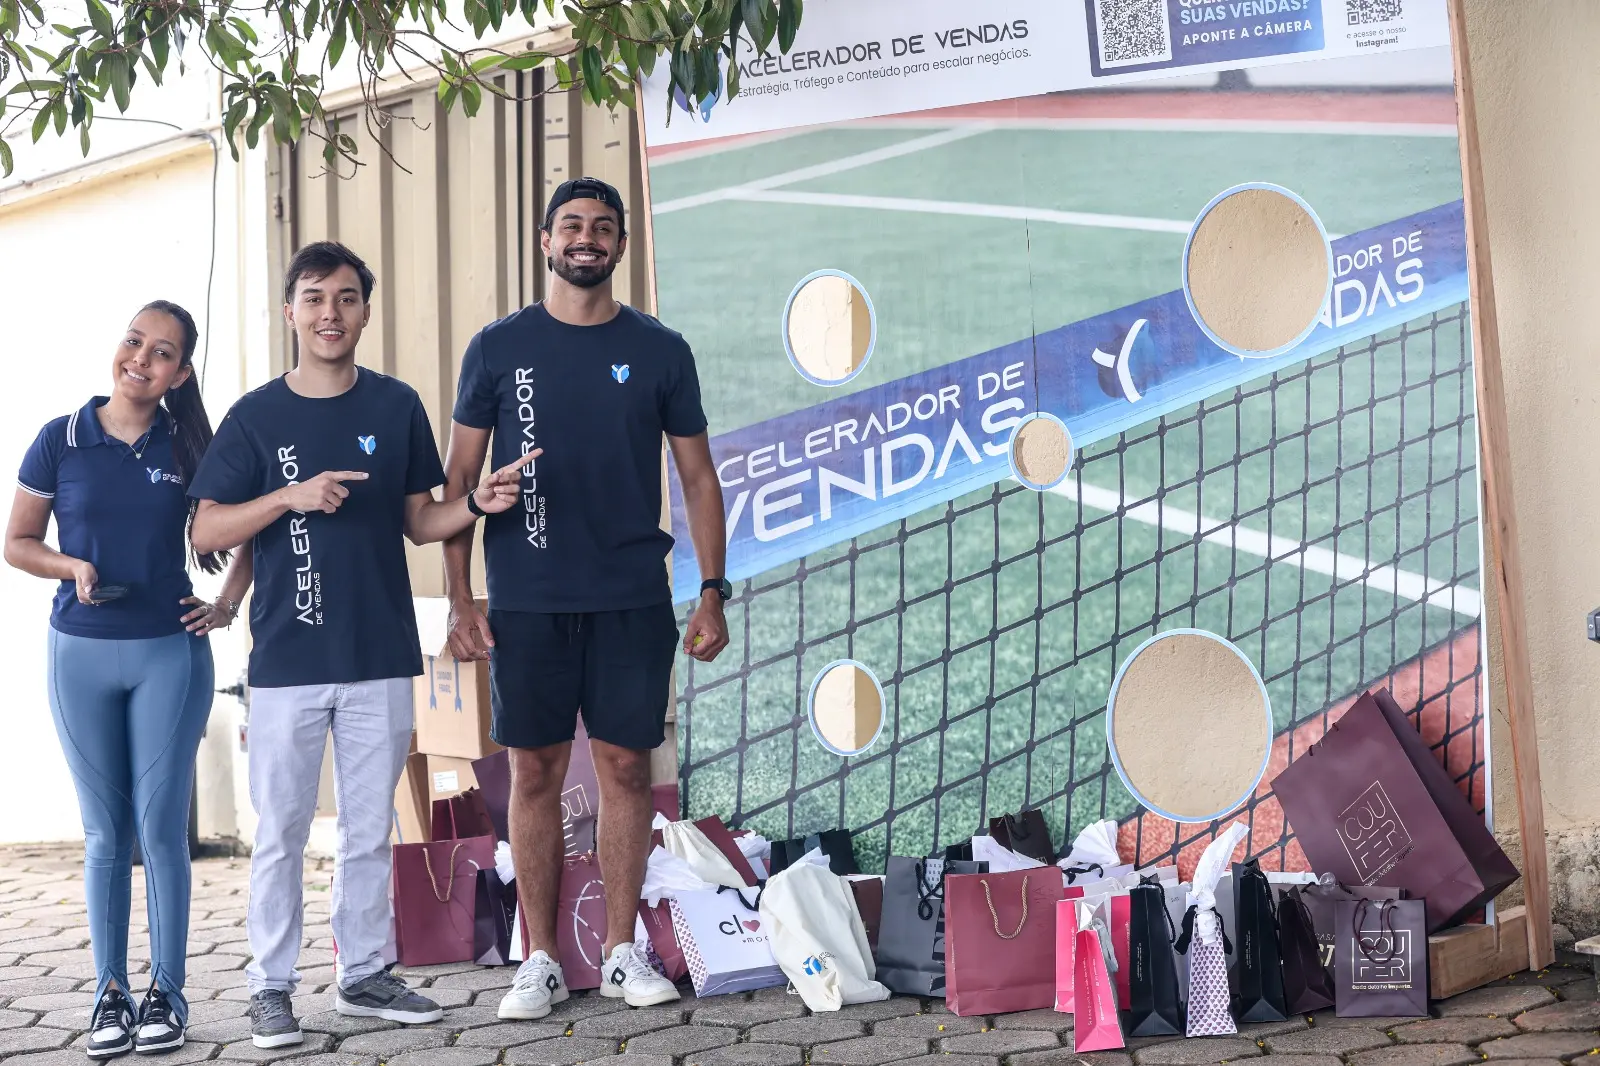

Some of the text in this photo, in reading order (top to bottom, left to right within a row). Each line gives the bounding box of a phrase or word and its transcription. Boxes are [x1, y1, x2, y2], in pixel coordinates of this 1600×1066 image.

[1180, 5, 1226, 25] SUAS
[1182, 19, 1313, 46] APONTE A CÂMERA
[1386, 26, 1407, 34] nosso
[739, 19, 1029, 78] ACELERADOR DE VENDAS
[1355, 35, 1399, 48] Instagram!
[738, 47, 1032, 98] Estratégia, Tráfego e Conteúdo para escalar negócios.
[1393, 230, 1423, 258] DE
[717, 361, 1026, 488] CELERADOR DE
[515, 367, 539, 548] ACELERADOR
[277, 444, 314, 626] ACELEROR
[538, 496, 547, 549] DE VENDAS
[313, 572, 323, 625] DE VENDAS
